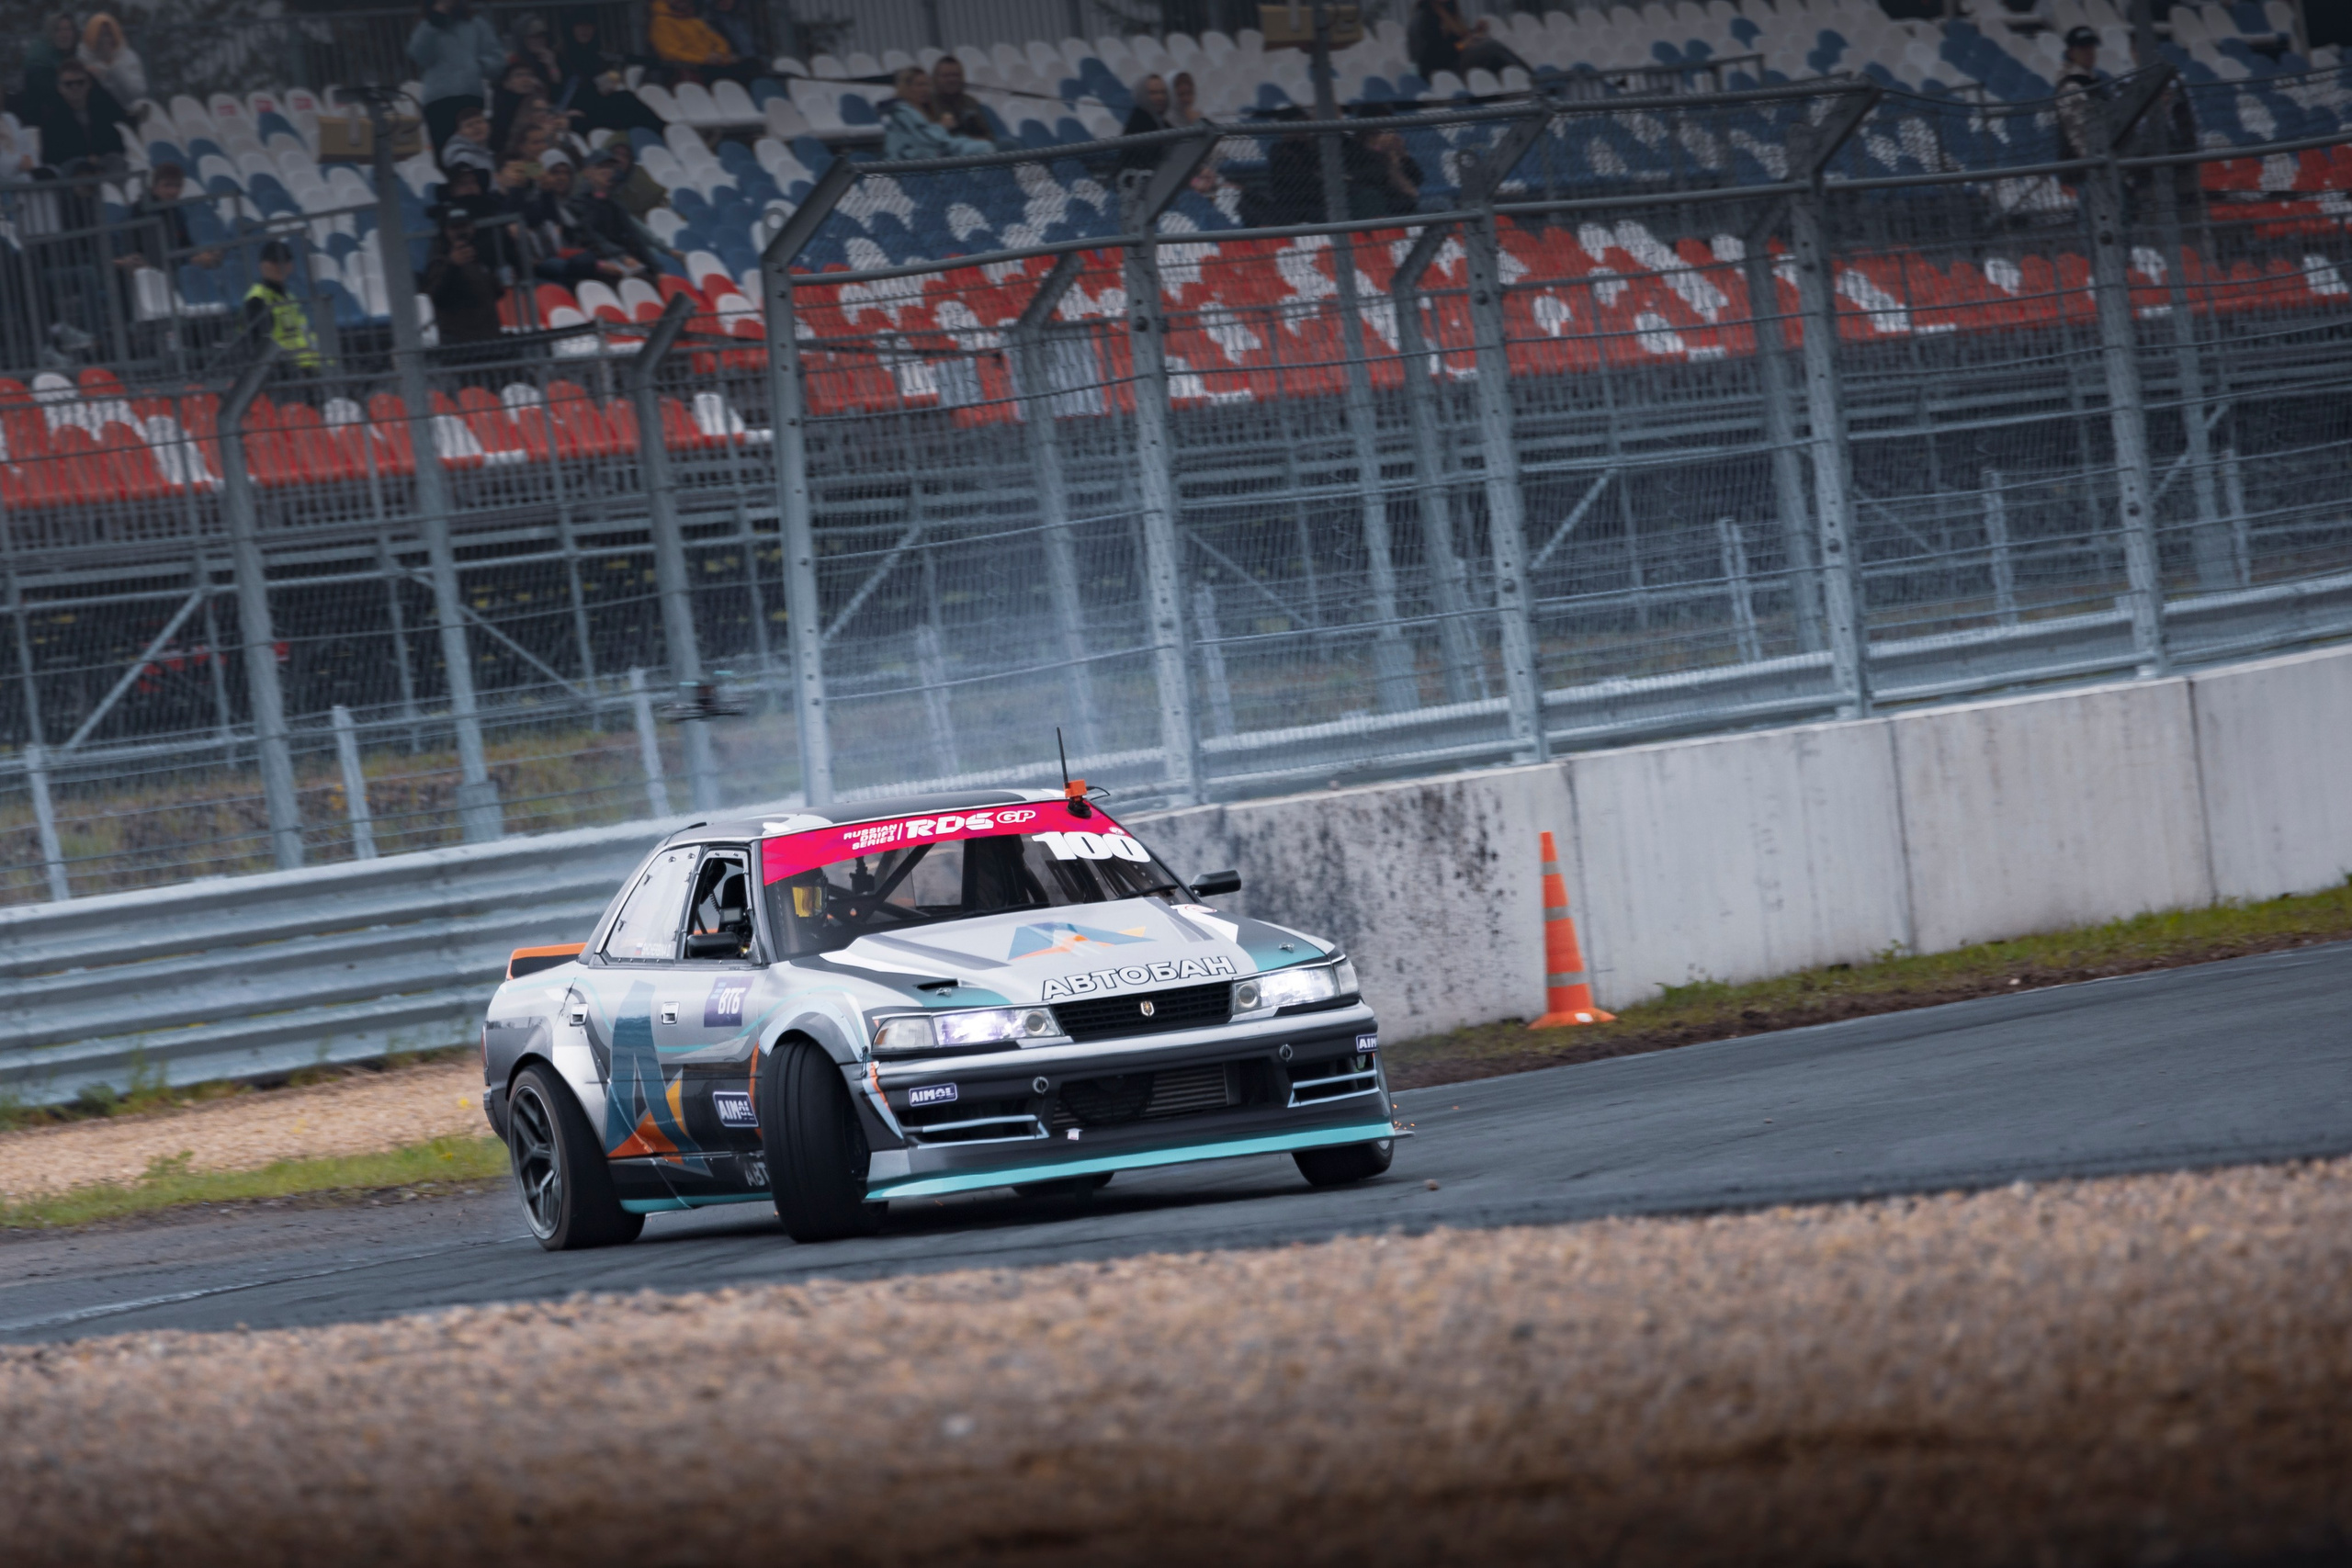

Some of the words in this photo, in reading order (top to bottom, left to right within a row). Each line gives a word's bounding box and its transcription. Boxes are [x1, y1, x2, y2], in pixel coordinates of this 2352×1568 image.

[843, 824, 898, 840] RUSSIAN
[905, 812, 994, 839] RDS
[996, 810, 1036, 823] GP
[852, 835, 895, 850] SERIES
[860, 830, 895, 842] DRIFT
[1031, 831, 1150, 863] 100
[1042, 955, 1238, 1001] АВТОБАН
[718, 987, 746, 1015] ВТБ
[911, 1087, 955, 1102] AIMOL
[718, 1100, 754, 1120] AIMOL
